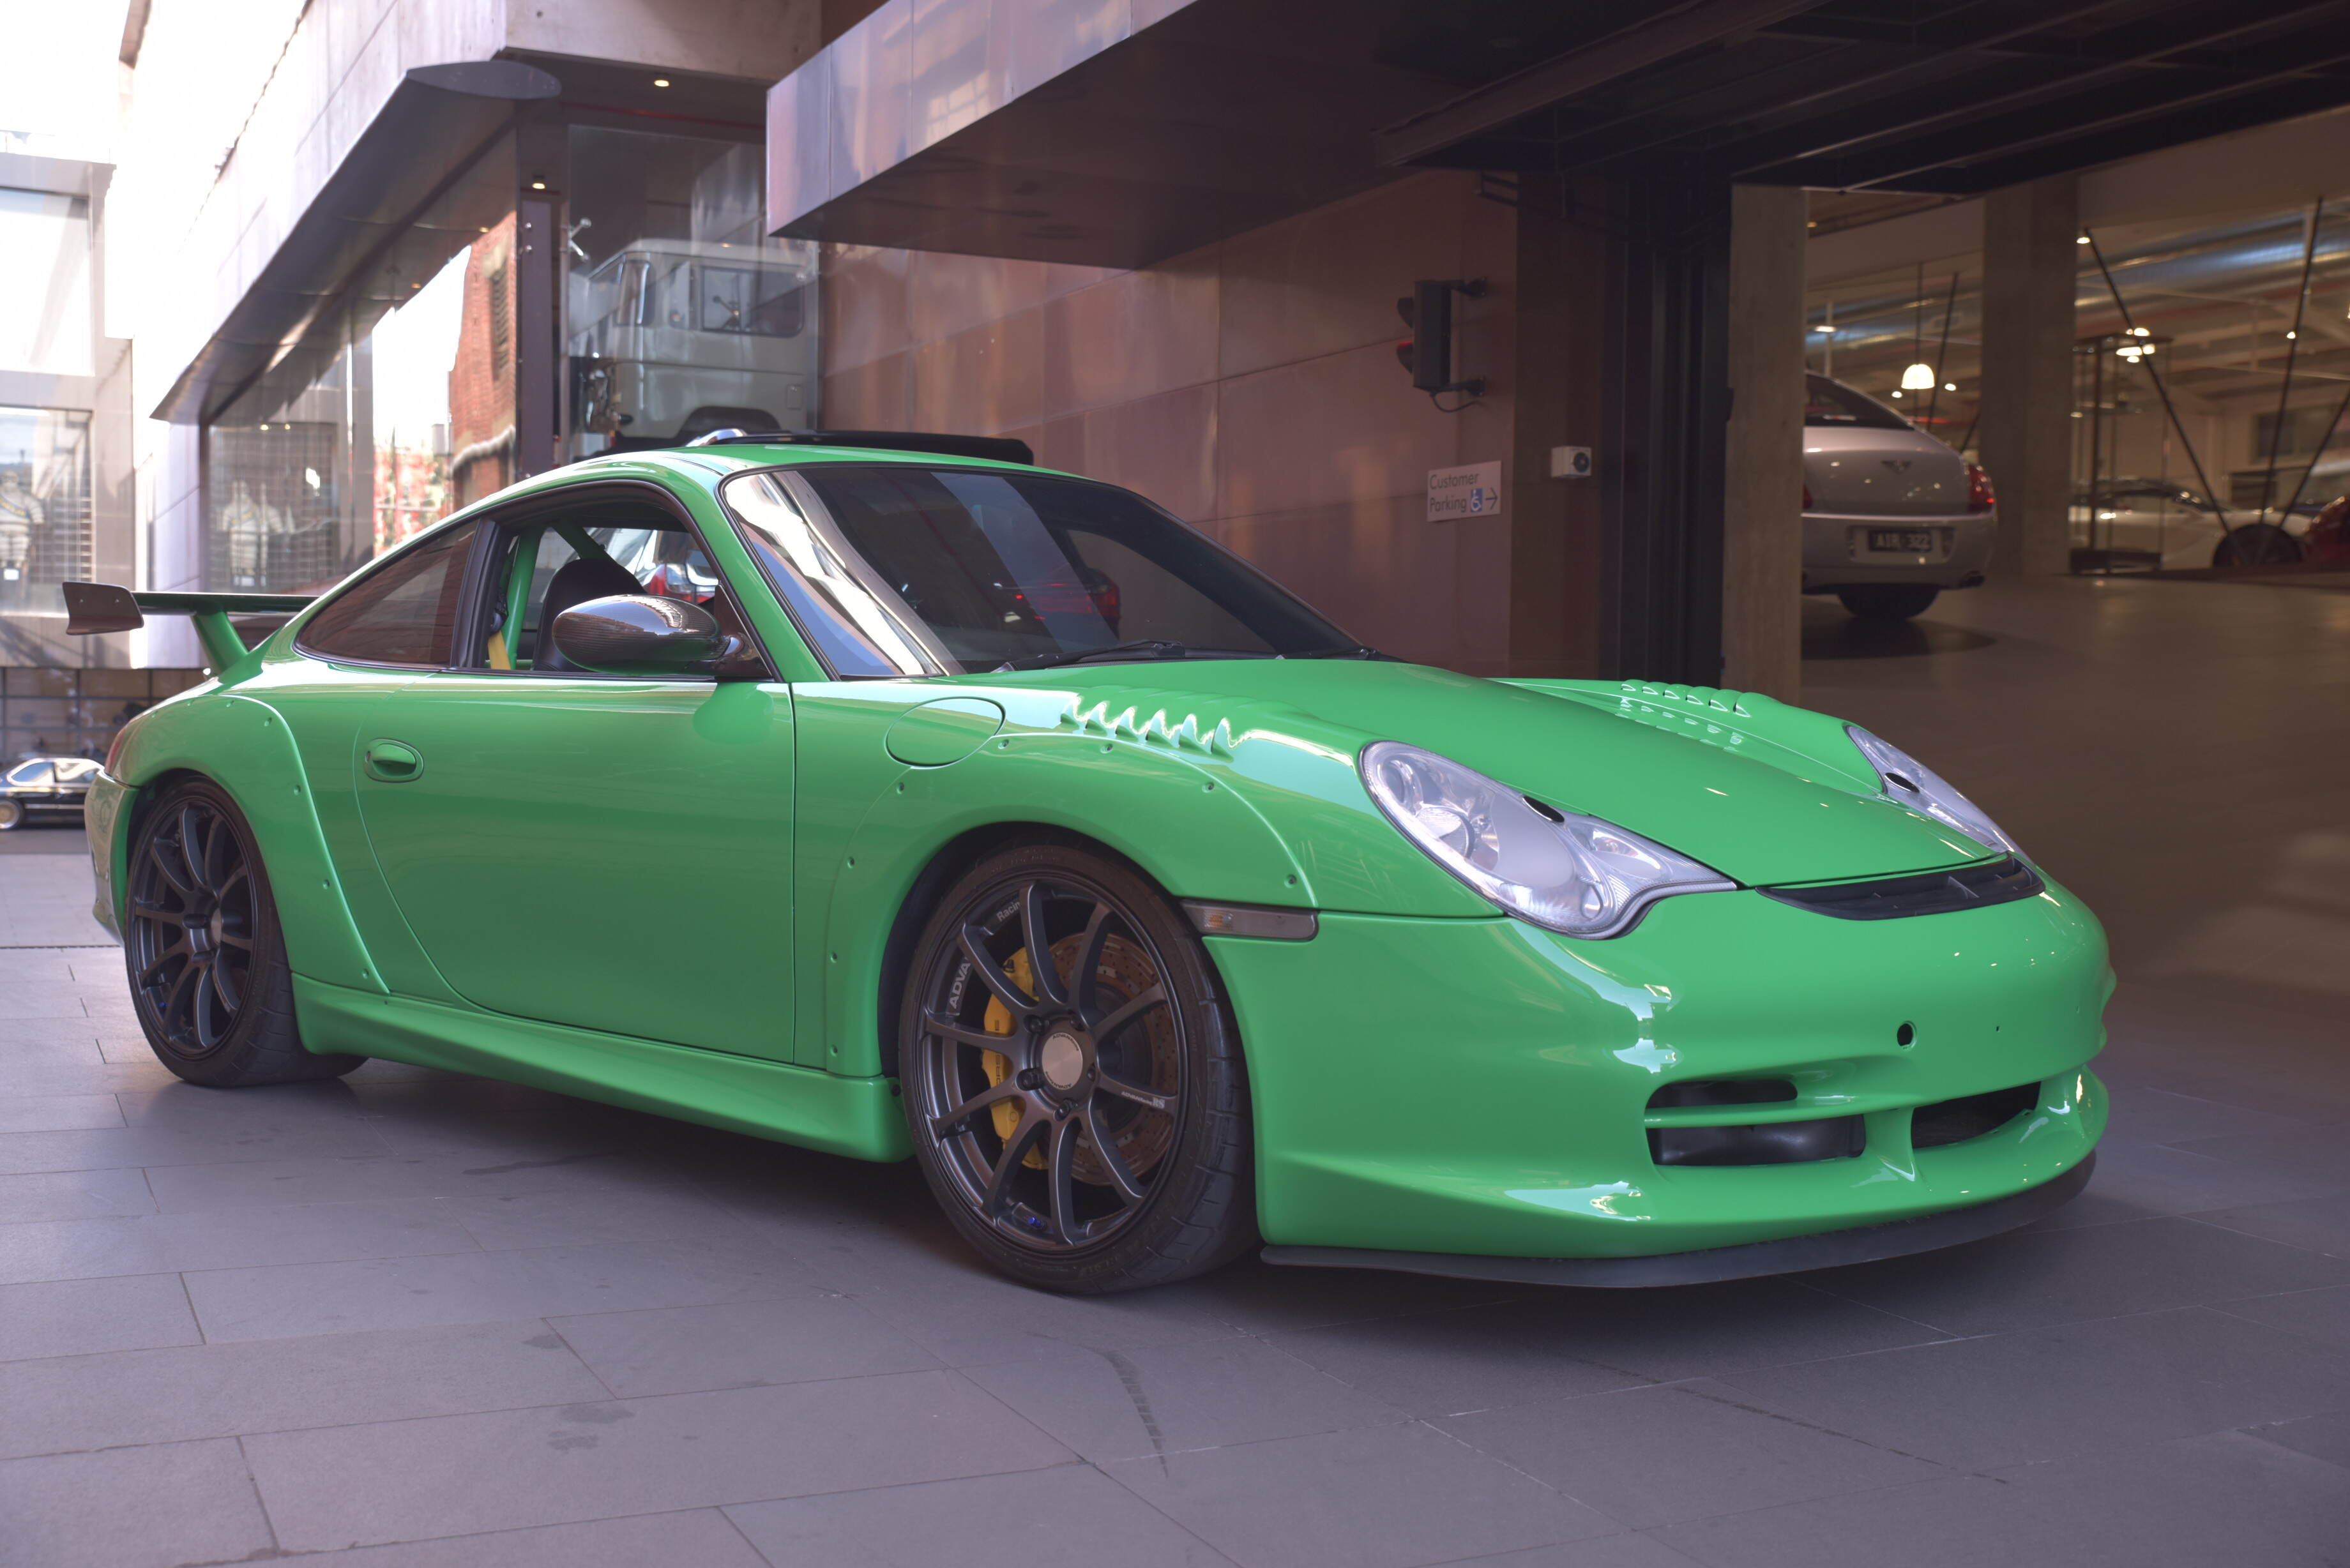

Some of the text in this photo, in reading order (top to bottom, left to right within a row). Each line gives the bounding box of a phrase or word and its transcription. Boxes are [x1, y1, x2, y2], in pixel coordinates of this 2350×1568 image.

[1430, 473, 1479, 490] Customer
[1430, 495, 1467, 513] Parking
[996, 901, 1022, 923] Racin
[950, 955, 971, 1009] ADVA
